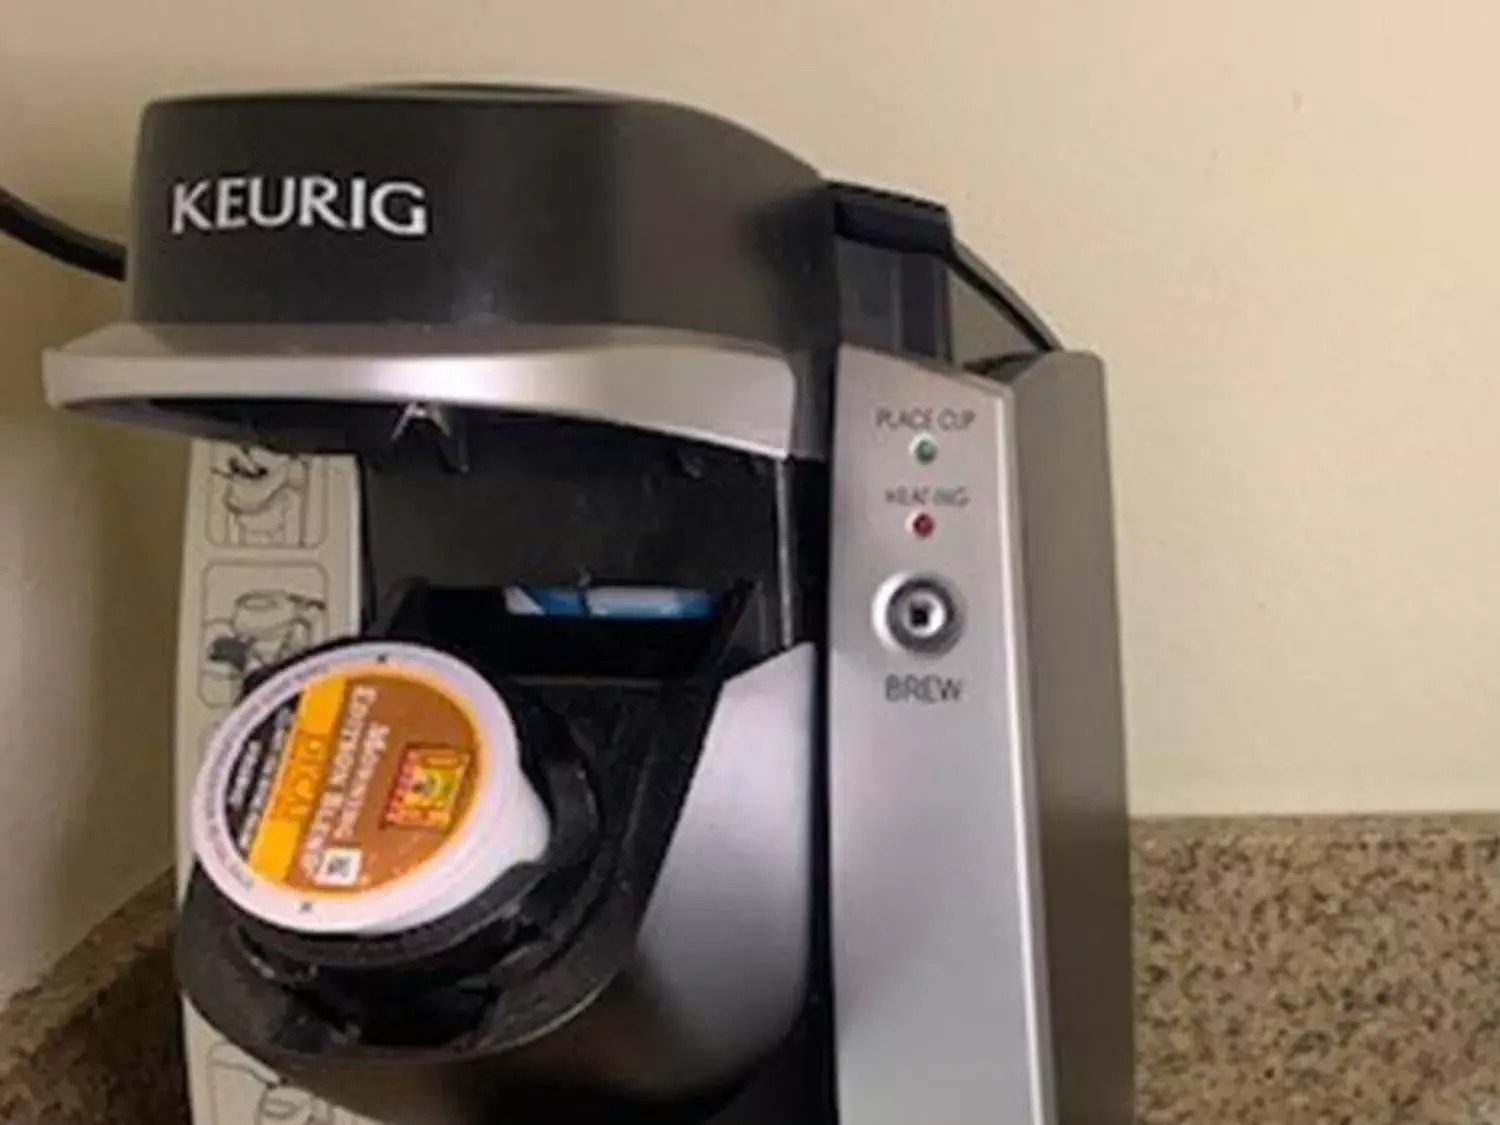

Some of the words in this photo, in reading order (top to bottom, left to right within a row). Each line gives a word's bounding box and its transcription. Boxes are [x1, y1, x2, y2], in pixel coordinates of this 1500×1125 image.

[171, 177, 427, 235] KEURIG
[937, 408, 976, 430] CUP
[884, 674, 963, 702] BREW
